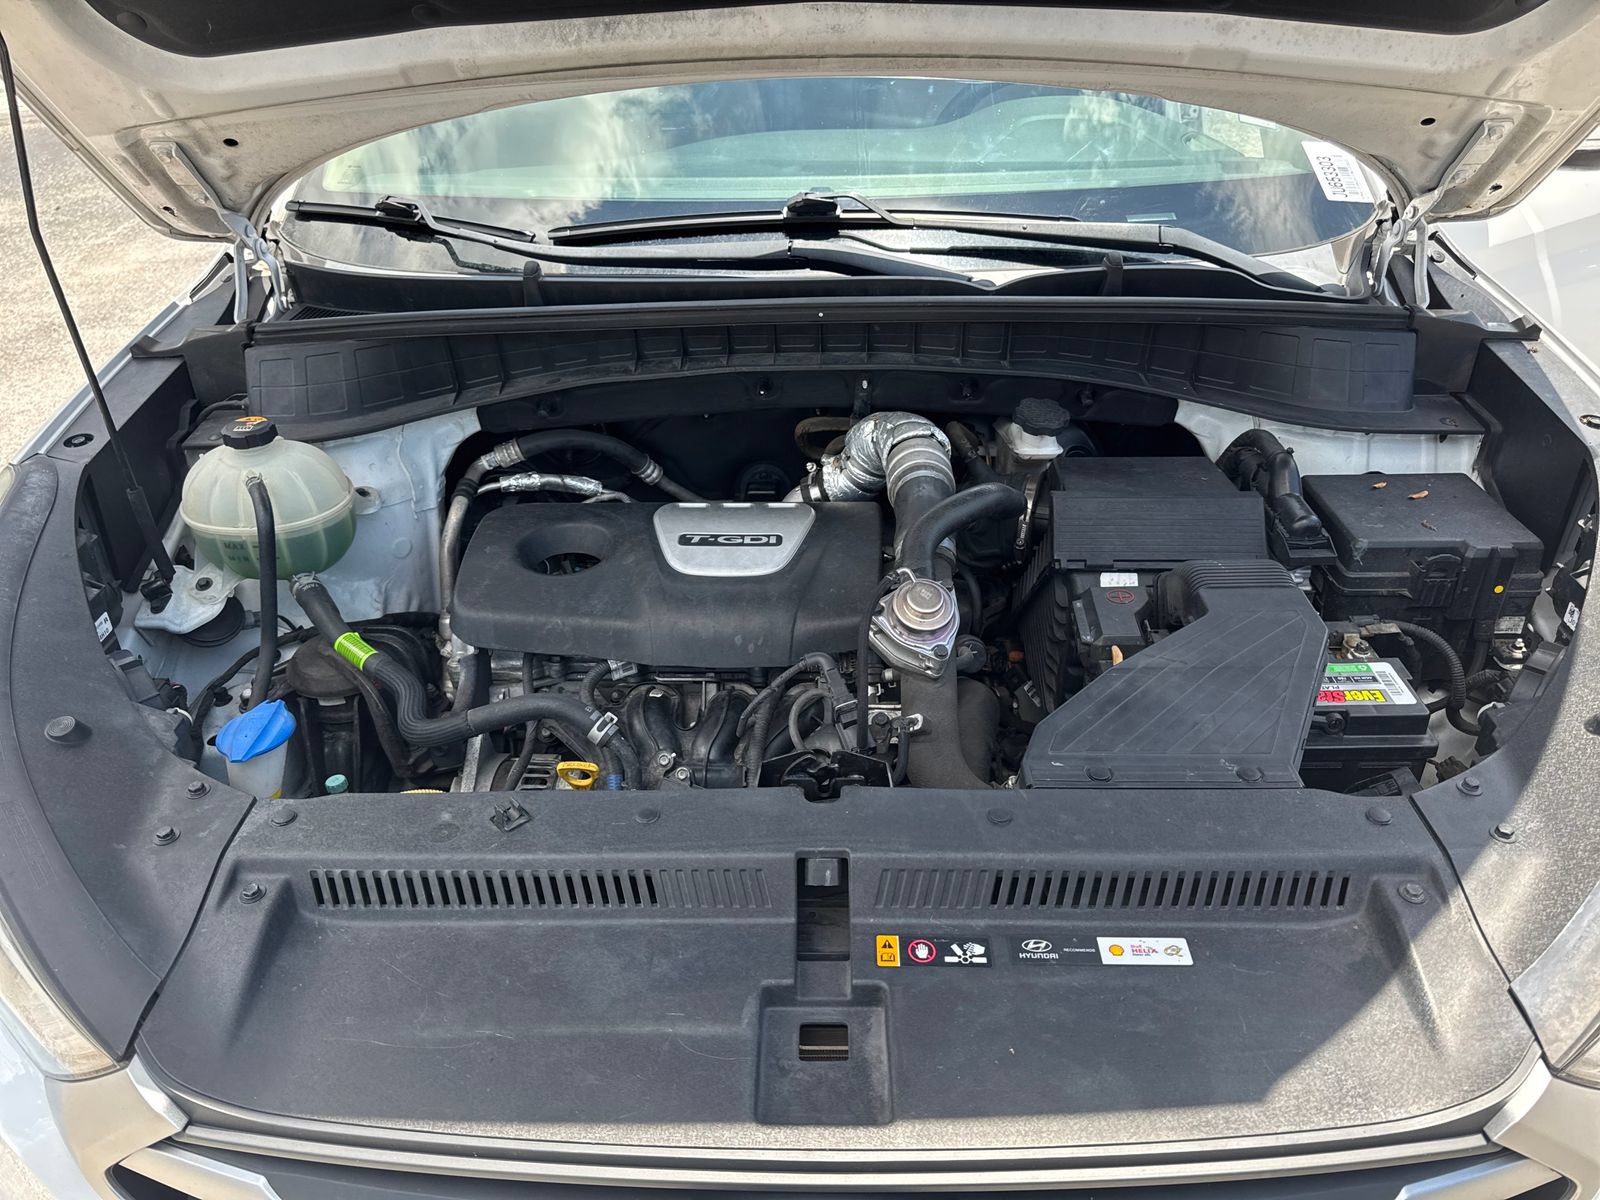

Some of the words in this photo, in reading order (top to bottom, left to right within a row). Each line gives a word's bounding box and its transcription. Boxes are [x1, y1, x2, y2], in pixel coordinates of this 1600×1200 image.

[1316, 156, 1348, 198] JU653303
[685, 534, 777, 544] T-GDI
[1019, 952, 1059, 960] HYUNDAI
